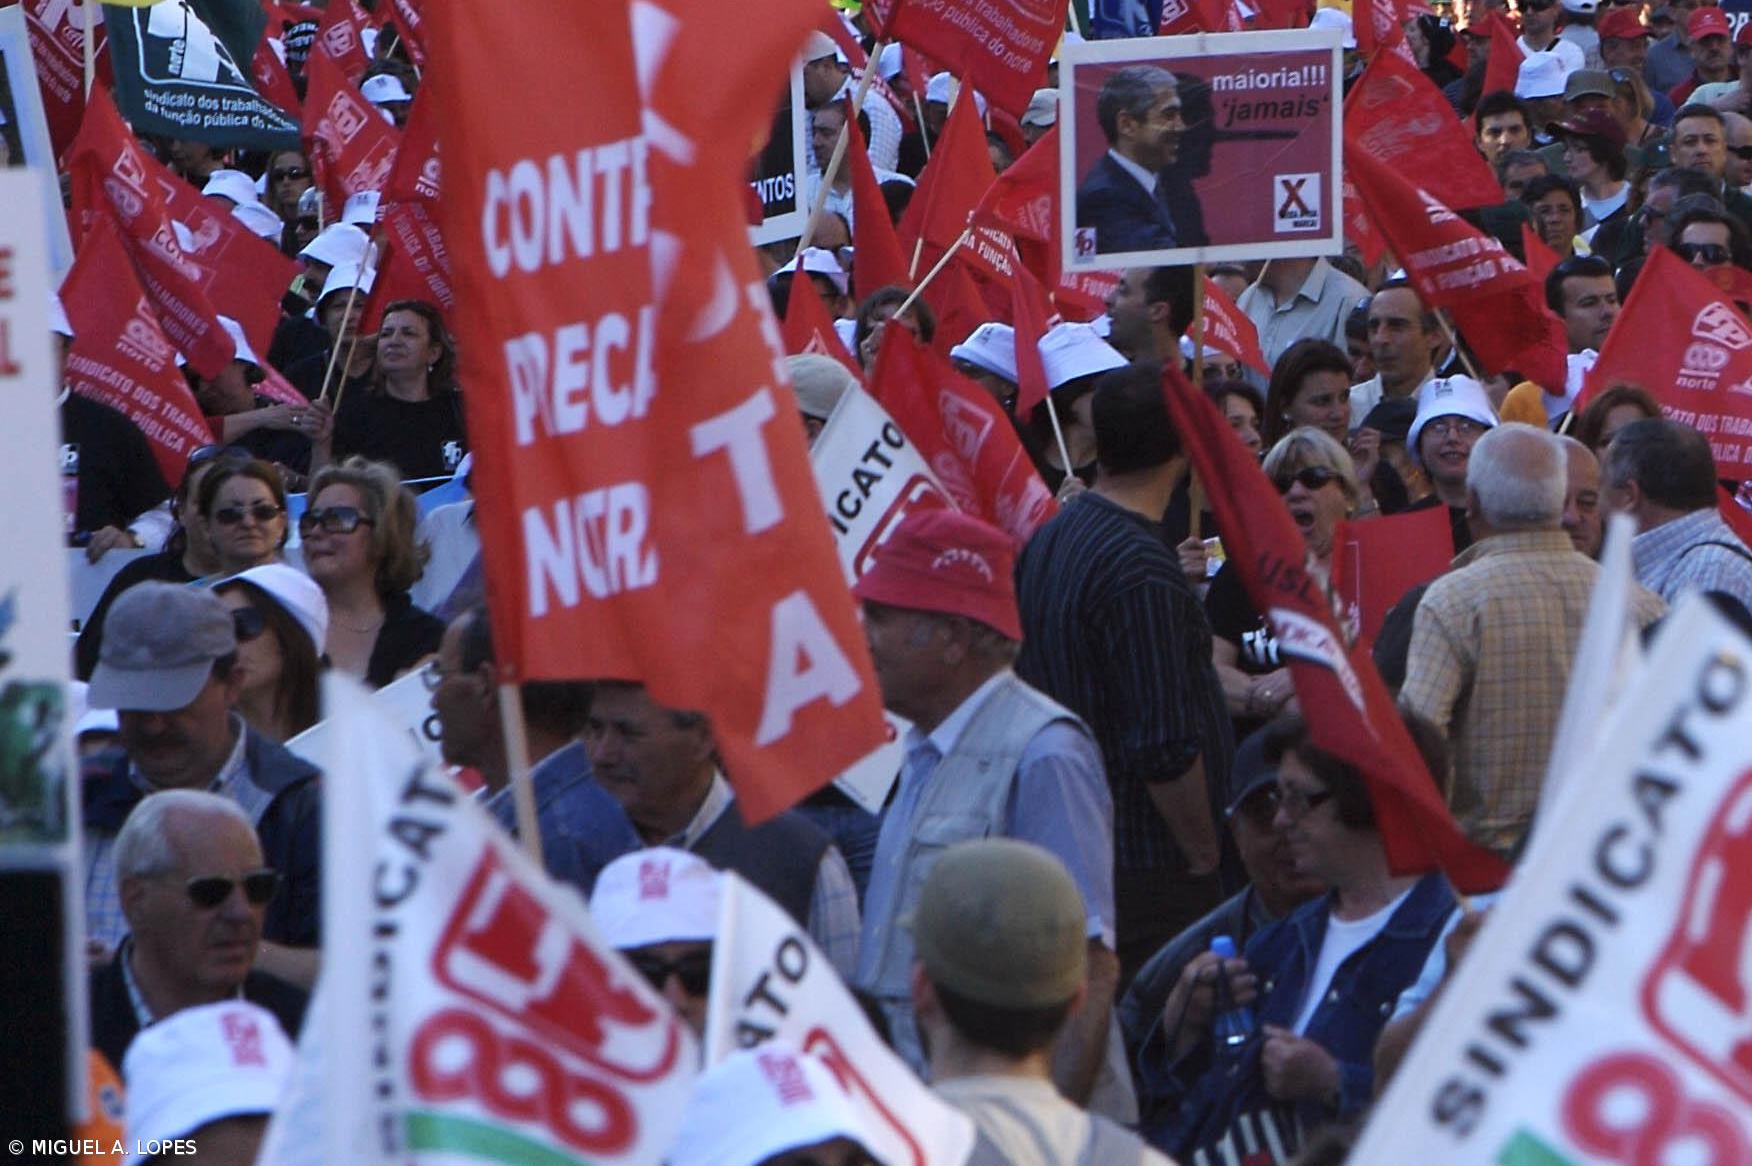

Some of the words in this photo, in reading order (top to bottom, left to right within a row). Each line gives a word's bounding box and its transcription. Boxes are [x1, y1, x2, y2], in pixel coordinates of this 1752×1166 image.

[168, 39, 186, 75] norte
[985, 34, 1008, 56] do
[1212, 65, 1326, 91] maioria!!!
[144, 89, 195, 108] sindicato
[198, 93, 219, 110] dos
[144, 101, 159, 114] da
[160, 106, 201, 126] função
[204, 110, 249, 128] pública
[251, 115, 265, 130] do
[116, 340, 165, 373] norte
[1676, 375, 1717, 391] norte
[1696, 413, 1720, 434] DOS
[1431, 652, 1749, 1136] SINDICATO
